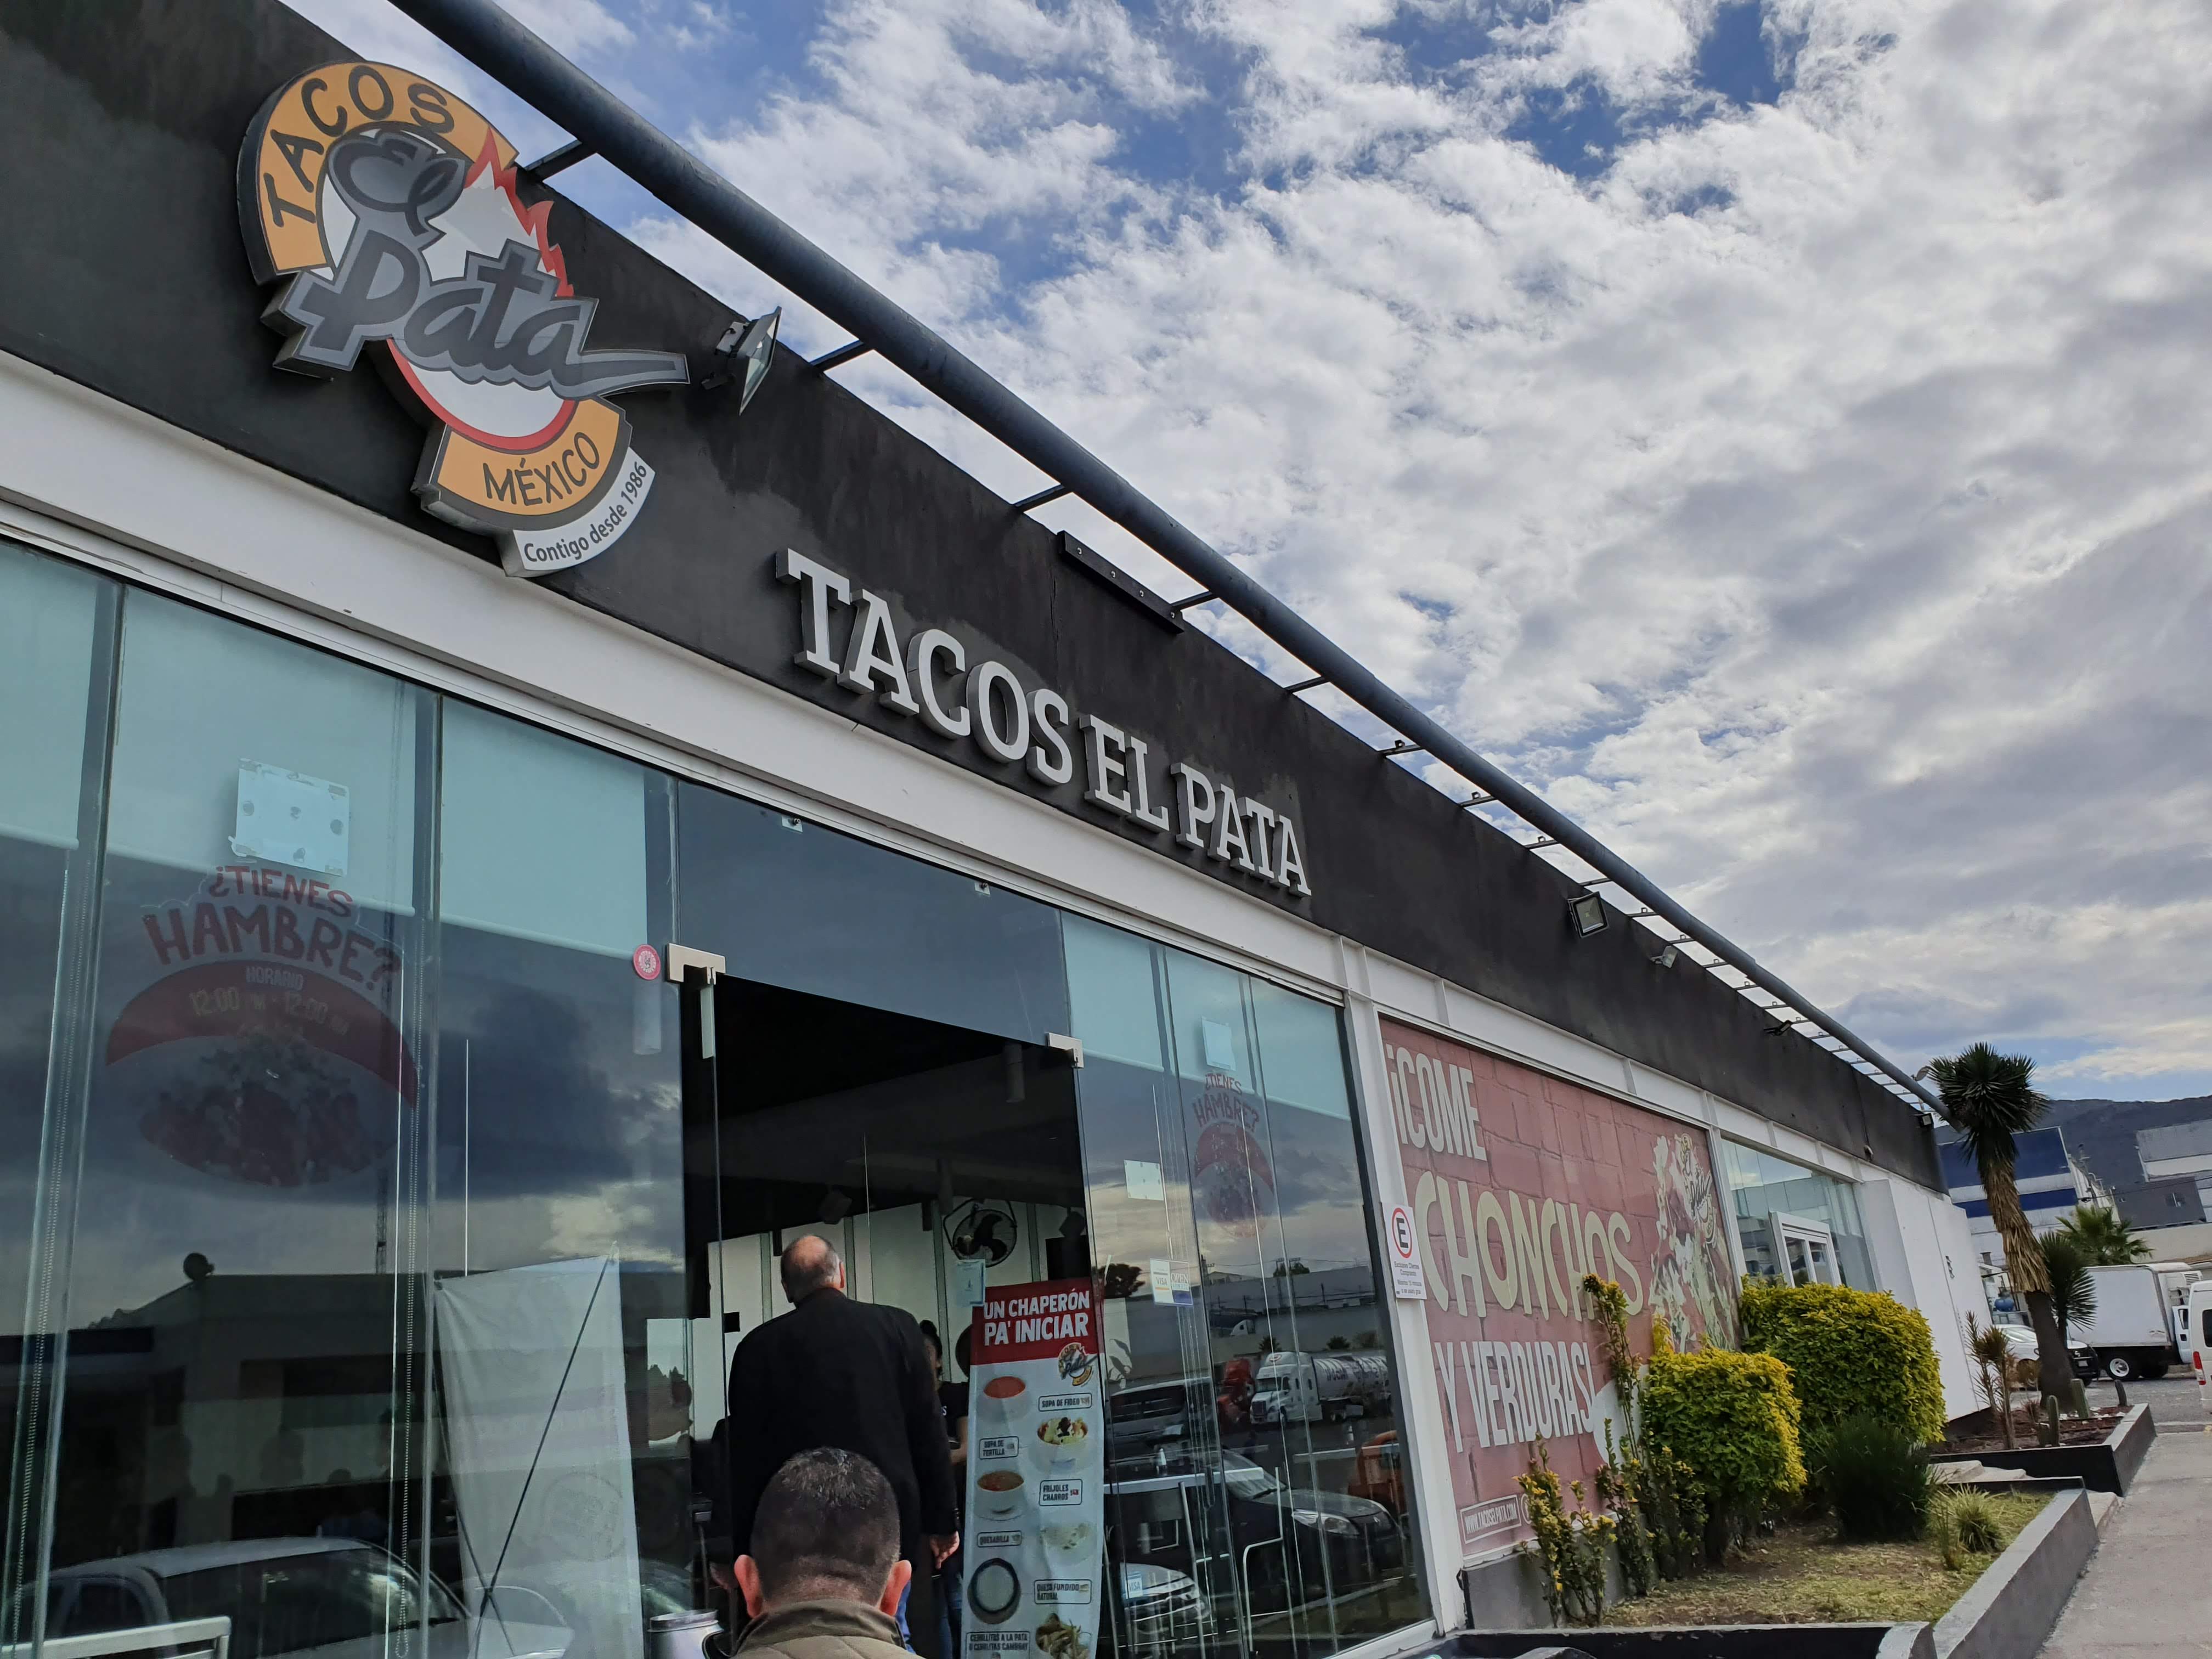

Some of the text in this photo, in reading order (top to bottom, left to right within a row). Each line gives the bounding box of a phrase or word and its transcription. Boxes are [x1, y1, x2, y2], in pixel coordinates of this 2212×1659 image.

[263, 65, 455, 229] TACOS
[298, 233, 678, 383] Pata
[483, 431, 601, 506] MÉXICO
[524, 461, 647, 562] Contigo desde 1986
[782, 549, 1312, 896] TACOS EL PATA
[208, 865, 353, 918] ¿TIENES
[142, 903, 402, 991] HAMBRE?
[246, 966, 303, 991] HORARIO
[1192, 1092, 1260, 1132] HAMBRE?
[1386, 1043, 1487, 1161] ¡COME
[1396, 1217, 1408, 1249] E
[1414, 1170, 1645, 1322] CHONCHOS
[1155, 1277, 1167, 1285] VISA
[1171, 1272, 1188, 1284] OPEN
[984, 1288, 1090, 1319] UN CHAPERÓN
[984, 1312, 1089, 1346] PA' INICIAR
[1064, 1398, 1080, 1406] FIDEO
[1434, 1341, 1464, 1453] Y
[983, 1448, 1005, 1457] TORTILLA
[1043, 1484, 1069, 1492] FRIJOLES
[1043, 1493, 1069, 1501] CHARROS
[1128, 1581, 1141, 1592] VISA
